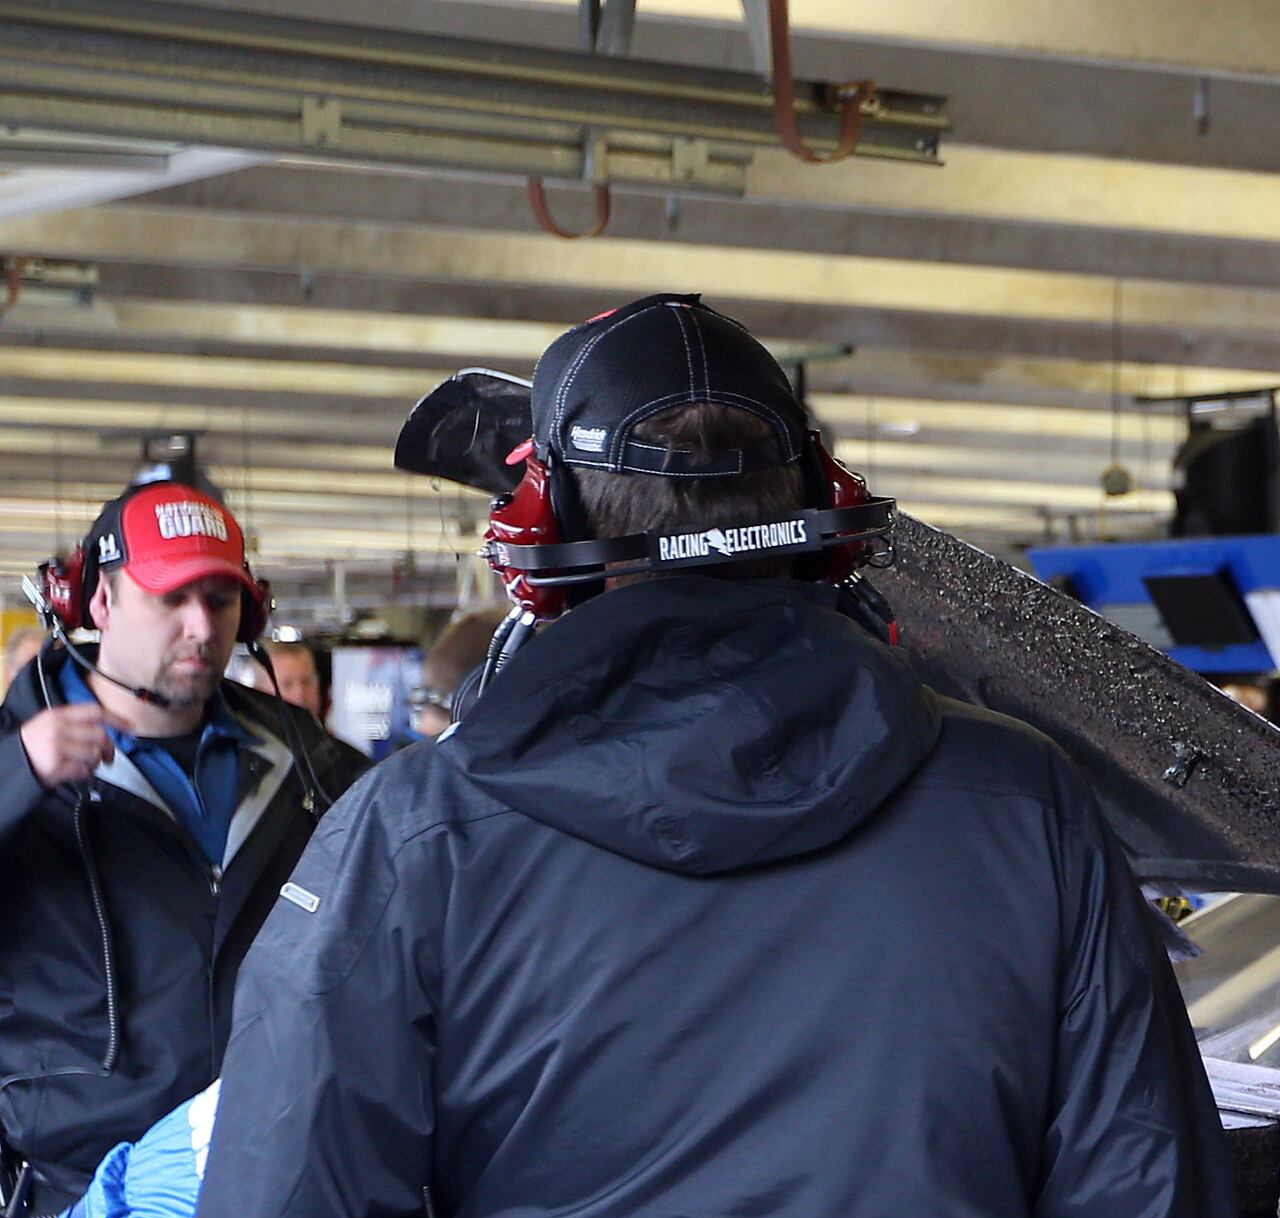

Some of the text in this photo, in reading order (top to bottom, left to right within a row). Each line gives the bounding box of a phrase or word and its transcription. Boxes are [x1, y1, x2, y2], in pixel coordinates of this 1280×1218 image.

[159, 511, 229, 543] GUARD
[659, 519, 807, 561] RACING ELECTRONICS
